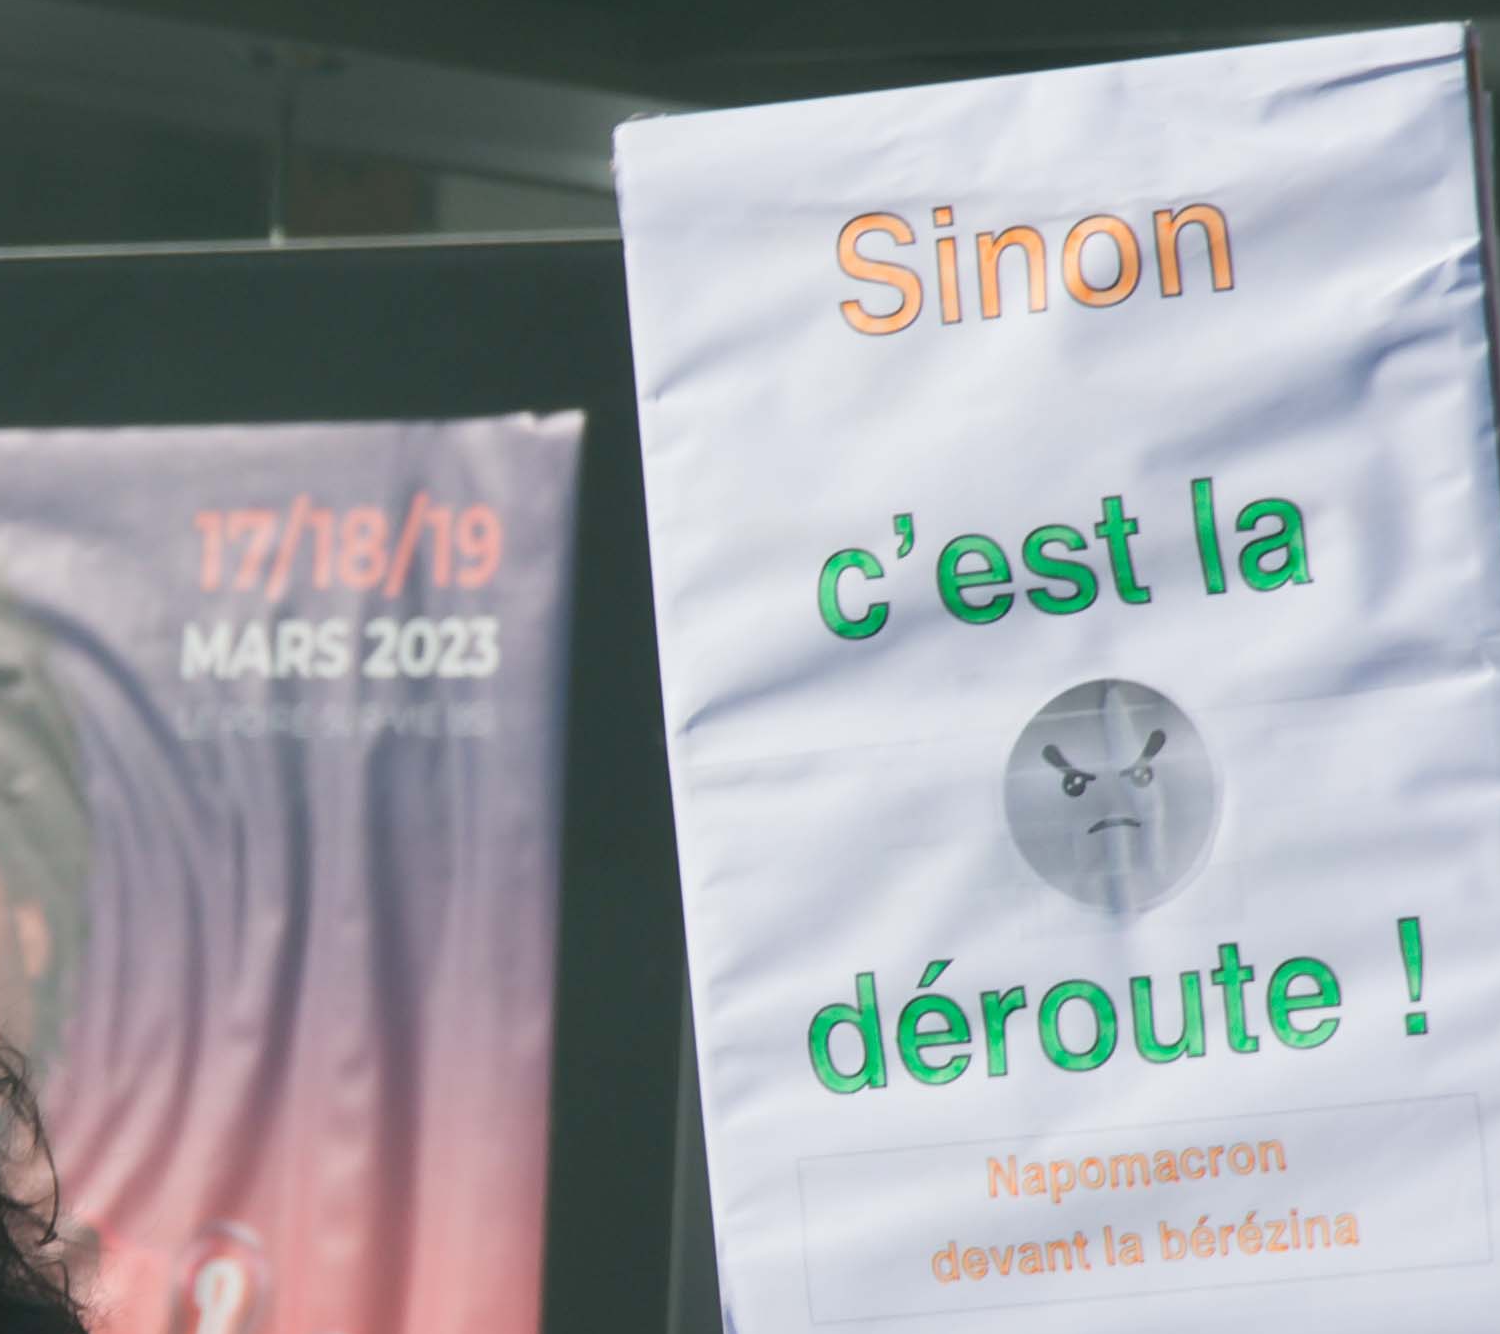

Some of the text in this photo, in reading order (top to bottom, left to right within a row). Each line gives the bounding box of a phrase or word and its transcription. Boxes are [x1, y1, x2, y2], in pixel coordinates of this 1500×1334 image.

[836, 202, 1234, 336] Sinon
[194, 491, 502, 603] 17/18/19
[817, 477, 1314, 640] c’est la
[180, 615, 501, 680] MARS 2023
[807, 916, 1428, 1095] déroute !
[985, 1137, 1288, 1205] Napomacron
[931, 1206, 1361, 1285] devant la bérézina
